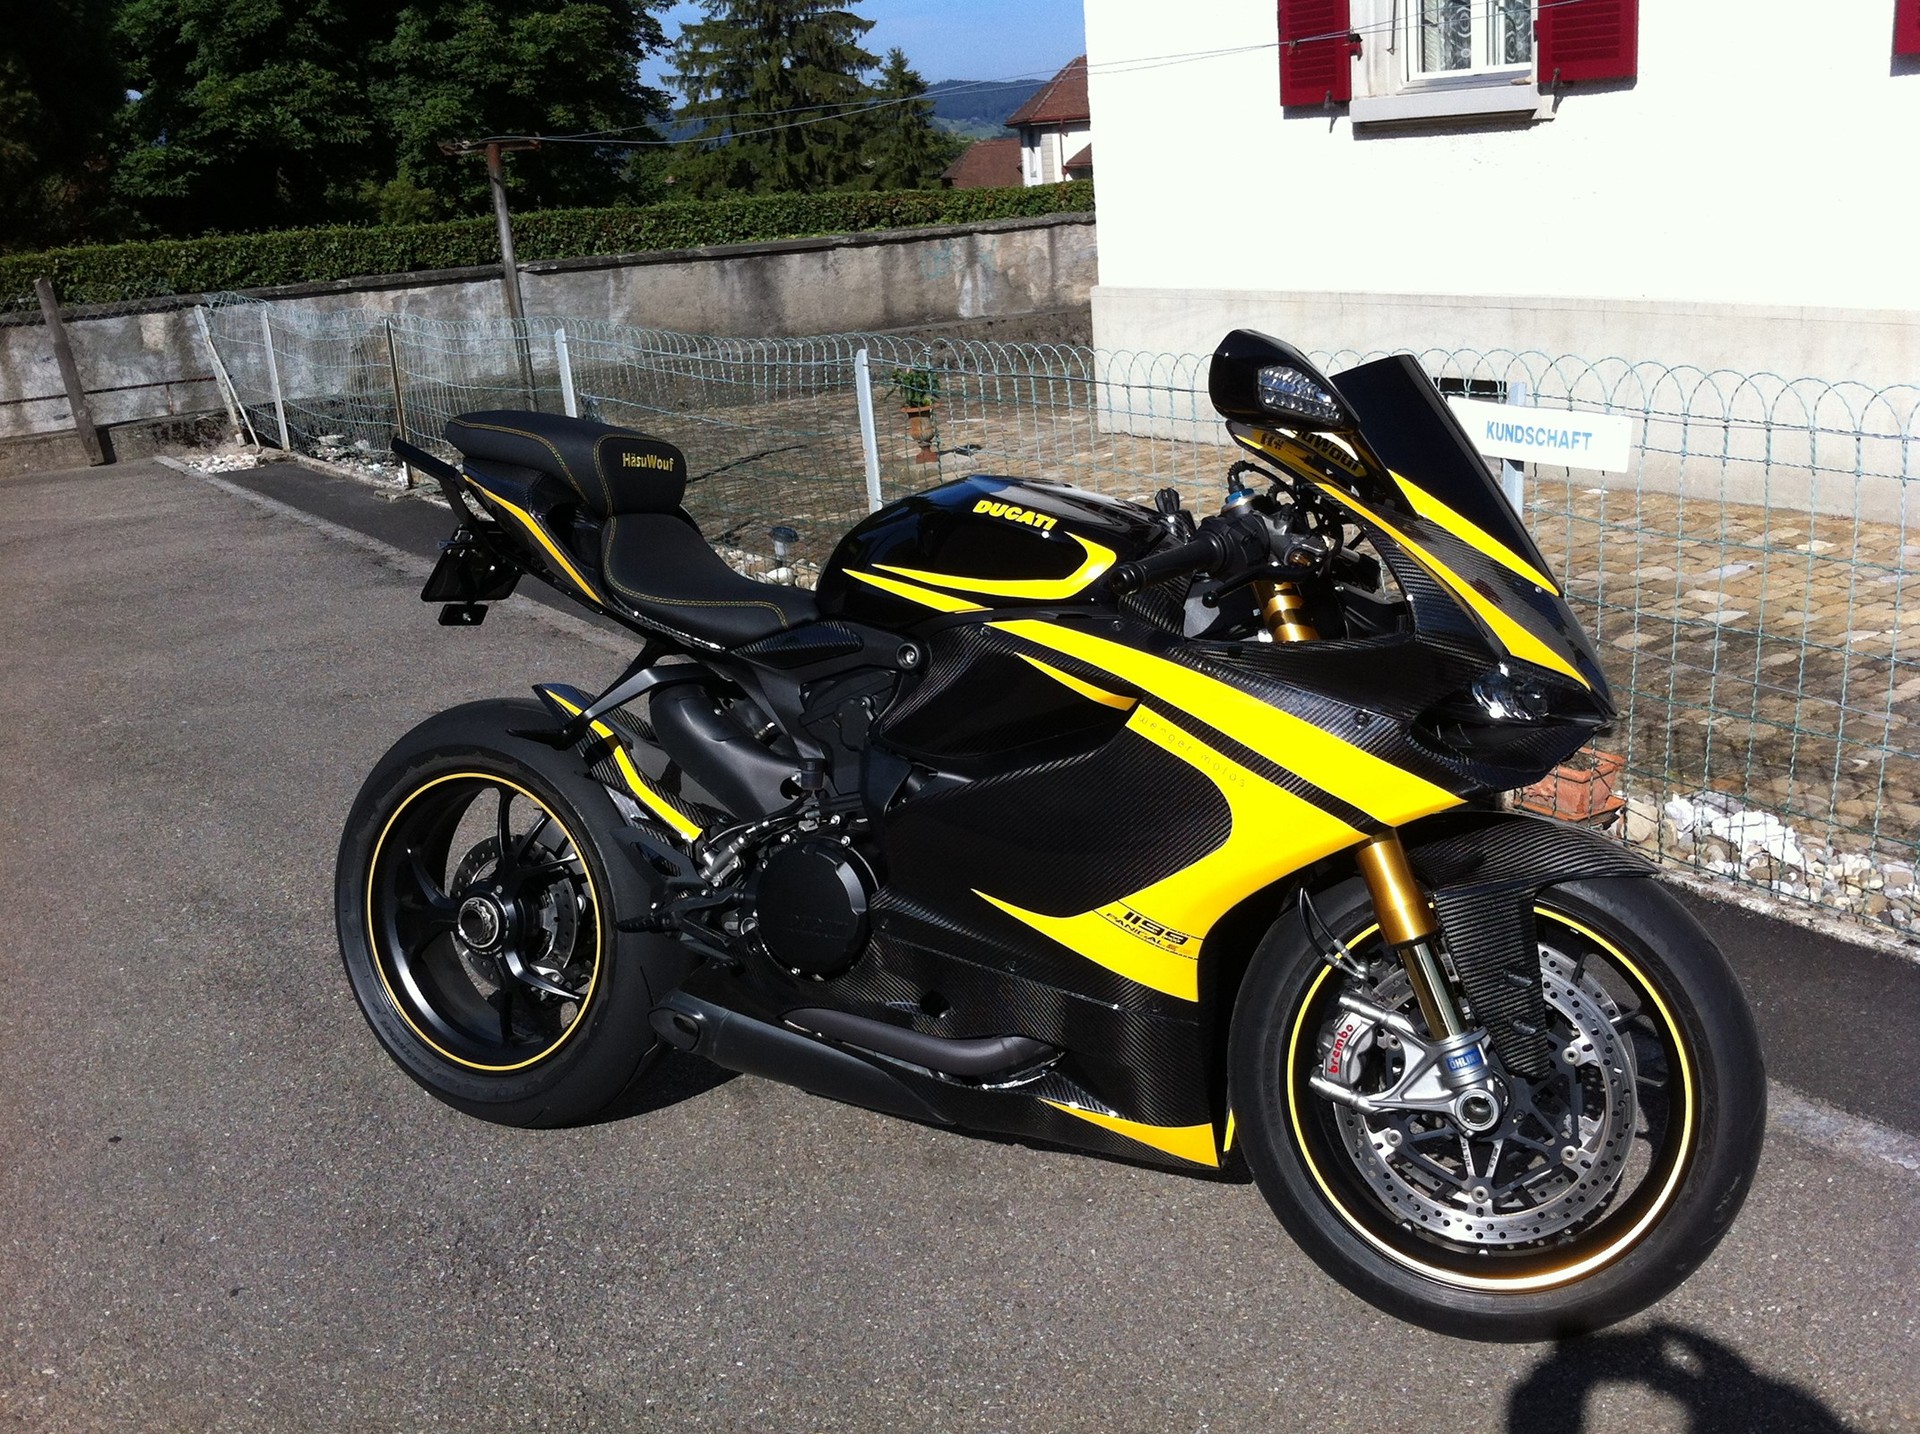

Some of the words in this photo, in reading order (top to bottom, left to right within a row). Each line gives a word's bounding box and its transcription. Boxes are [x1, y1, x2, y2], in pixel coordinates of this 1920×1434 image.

[1486, 420, 1592, 451] KUNDSCHAFT
[972, 500, 1058, 531] DUCATI
[1123, 911, 1189, 945] 1199
[1328, 1024, 1354, 1074] brembo
